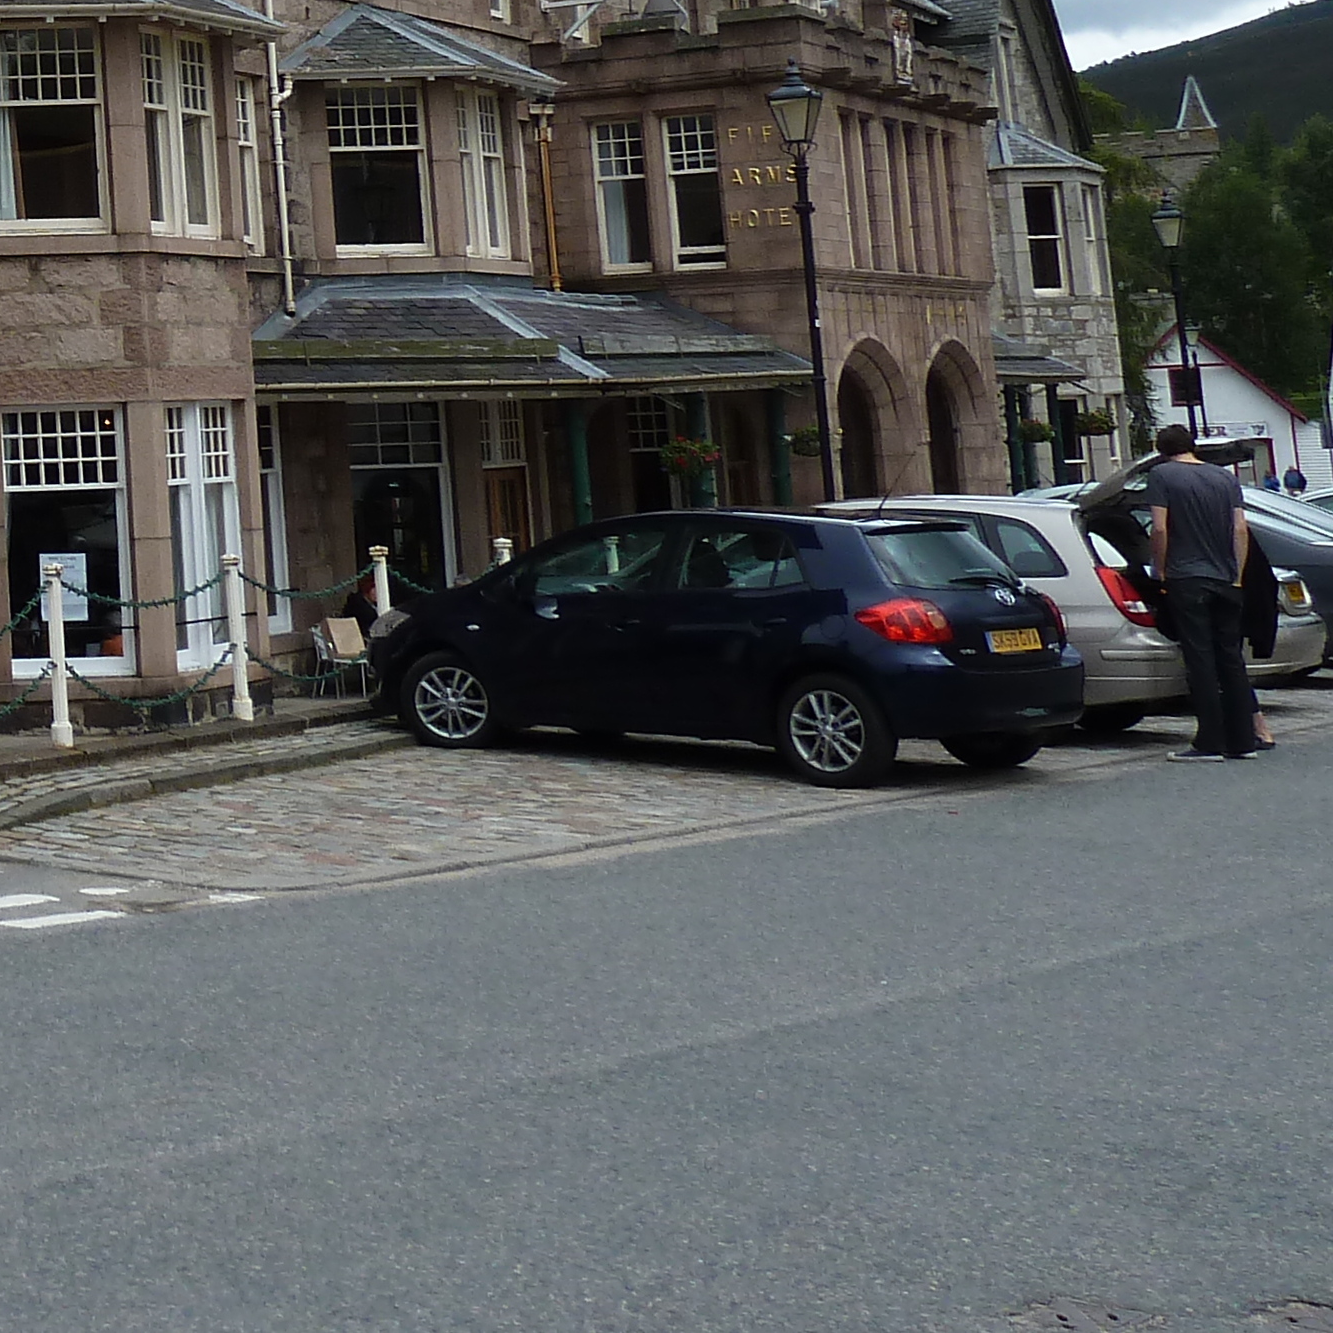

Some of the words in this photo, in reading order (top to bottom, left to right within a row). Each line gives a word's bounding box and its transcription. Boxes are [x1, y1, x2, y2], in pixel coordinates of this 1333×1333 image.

[728, 126, 772, 145] FIF
[732, 164, 797, 185] ARMS
[729, 208, 792, 228] HOTE
